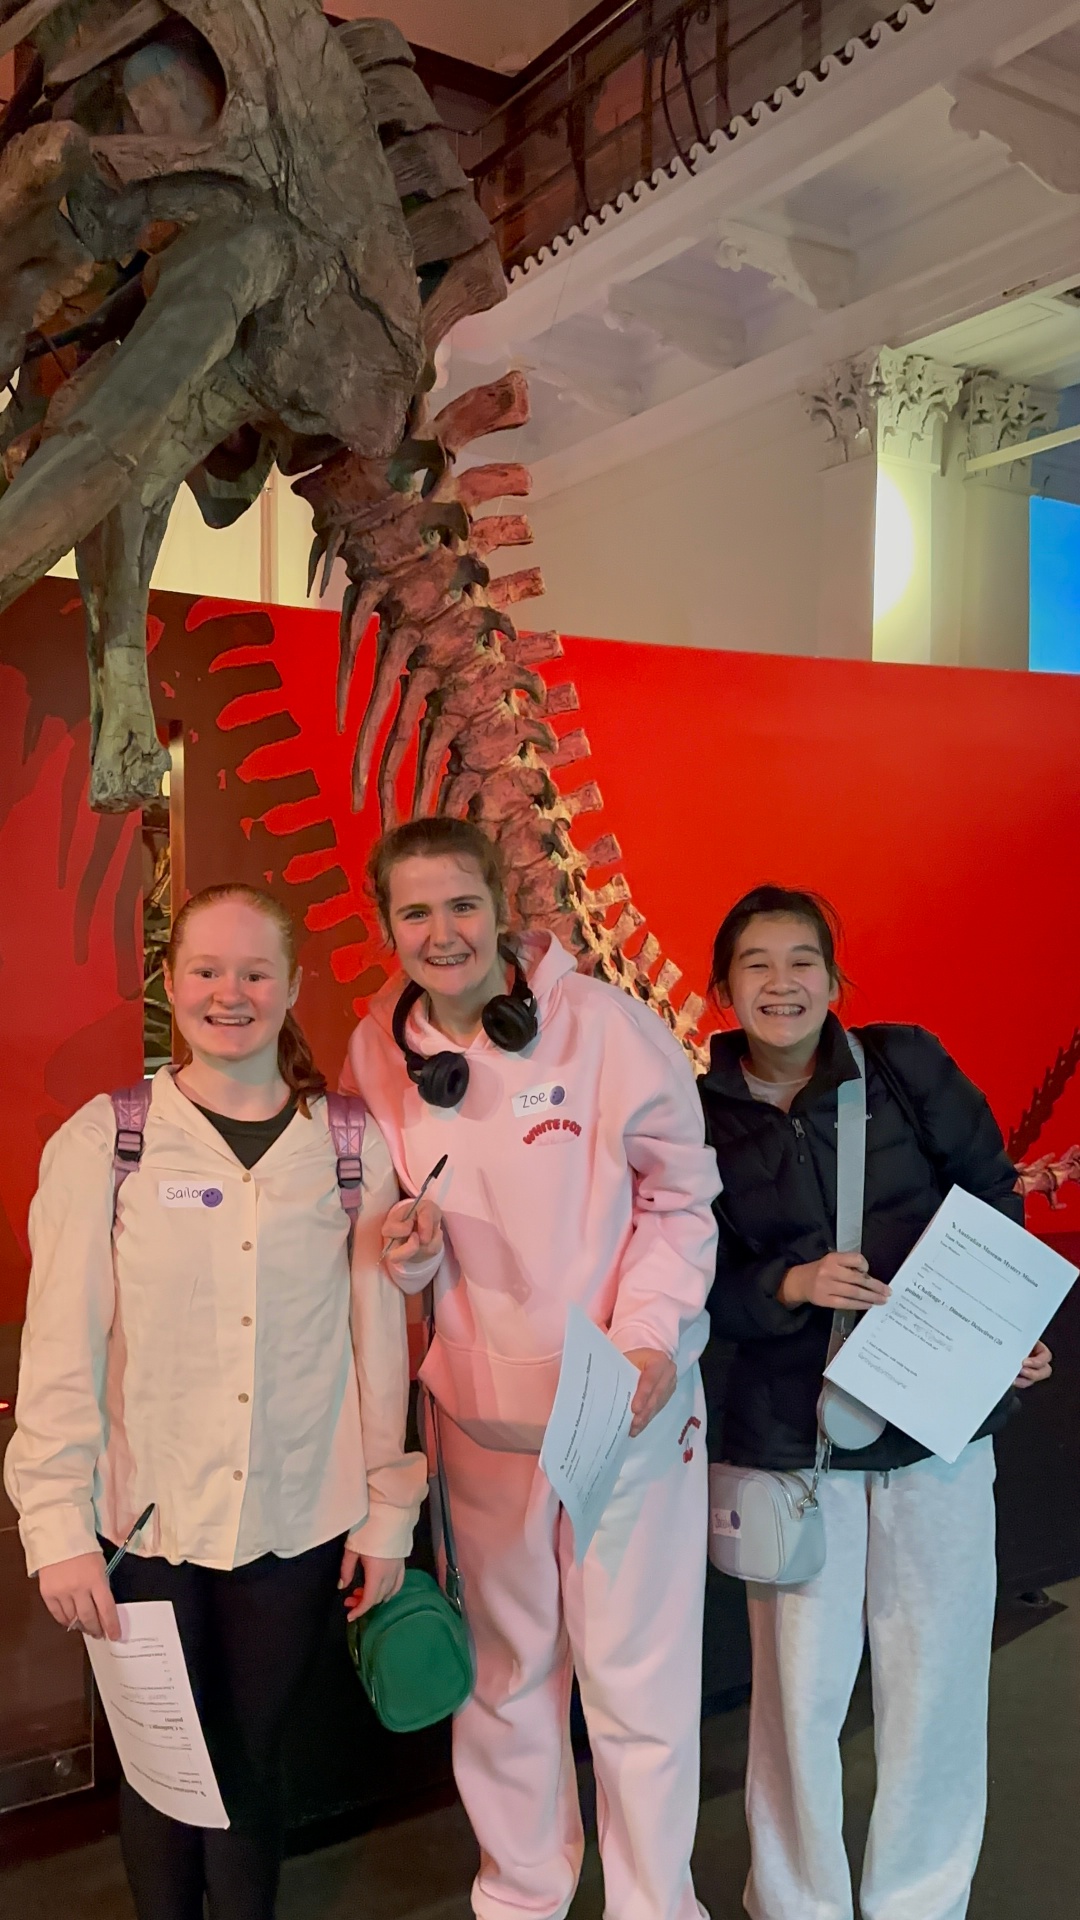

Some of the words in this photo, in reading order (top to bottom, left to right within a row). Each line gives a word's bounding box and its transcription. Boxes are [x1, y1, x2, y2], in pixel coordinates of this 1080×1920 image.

[519, 1092, 547, 1108] Zoe
[522, 1118, 560, 1145] WHITE
[562, 1118, 582, 1137] FOX
[917, 1283, 941, 1304] Challenge
